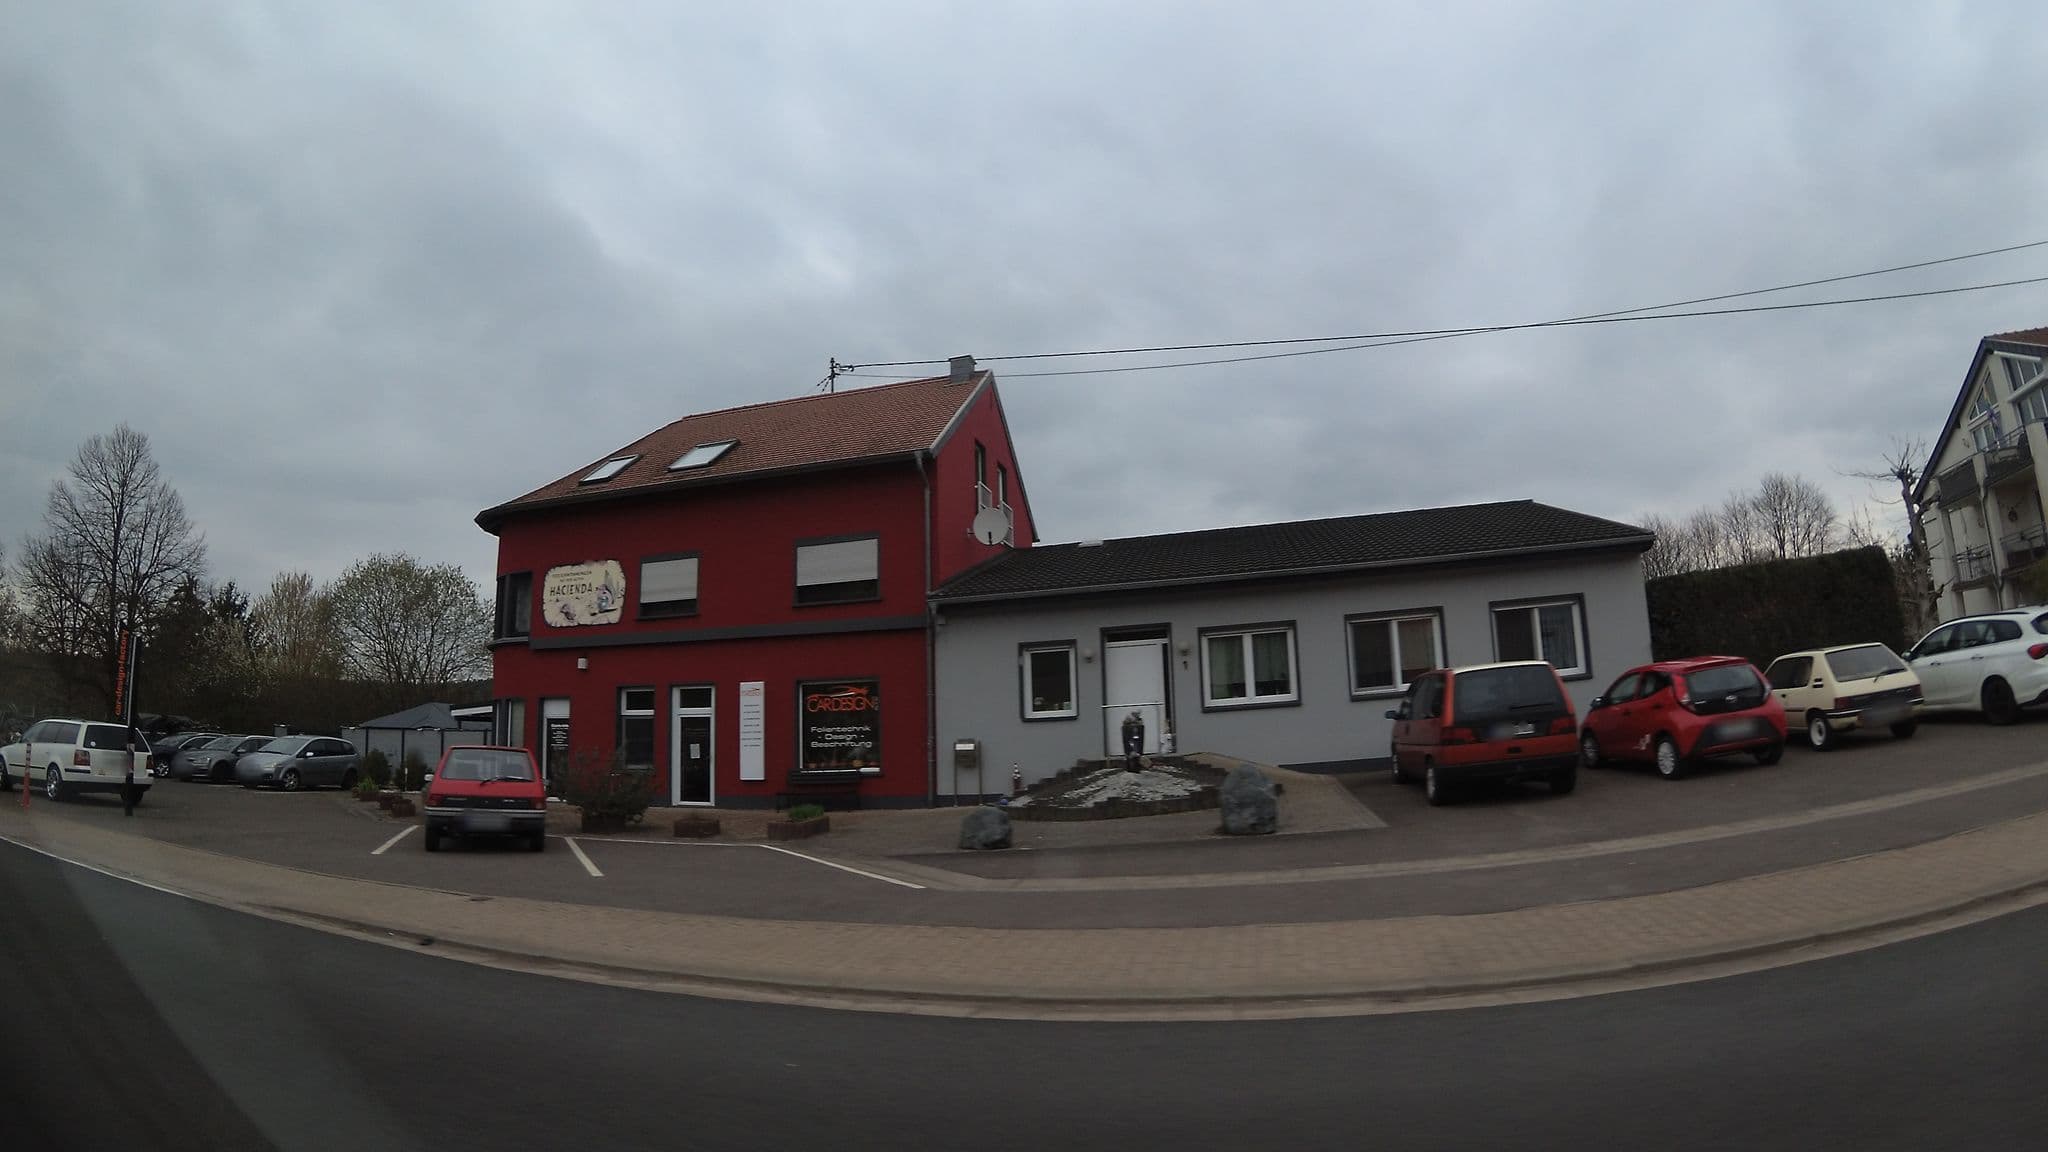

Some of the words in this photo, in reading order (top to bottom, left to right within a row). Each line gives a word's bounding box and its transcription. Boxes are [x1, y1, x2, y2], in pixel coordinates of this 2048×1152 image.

[550, 582, 592, 596] HACIENDA
[115, 629, 129, 715] car-design-factory
[808, 695, 873, 712] CARDESIGN
[825, 733, 857, 741] Design
